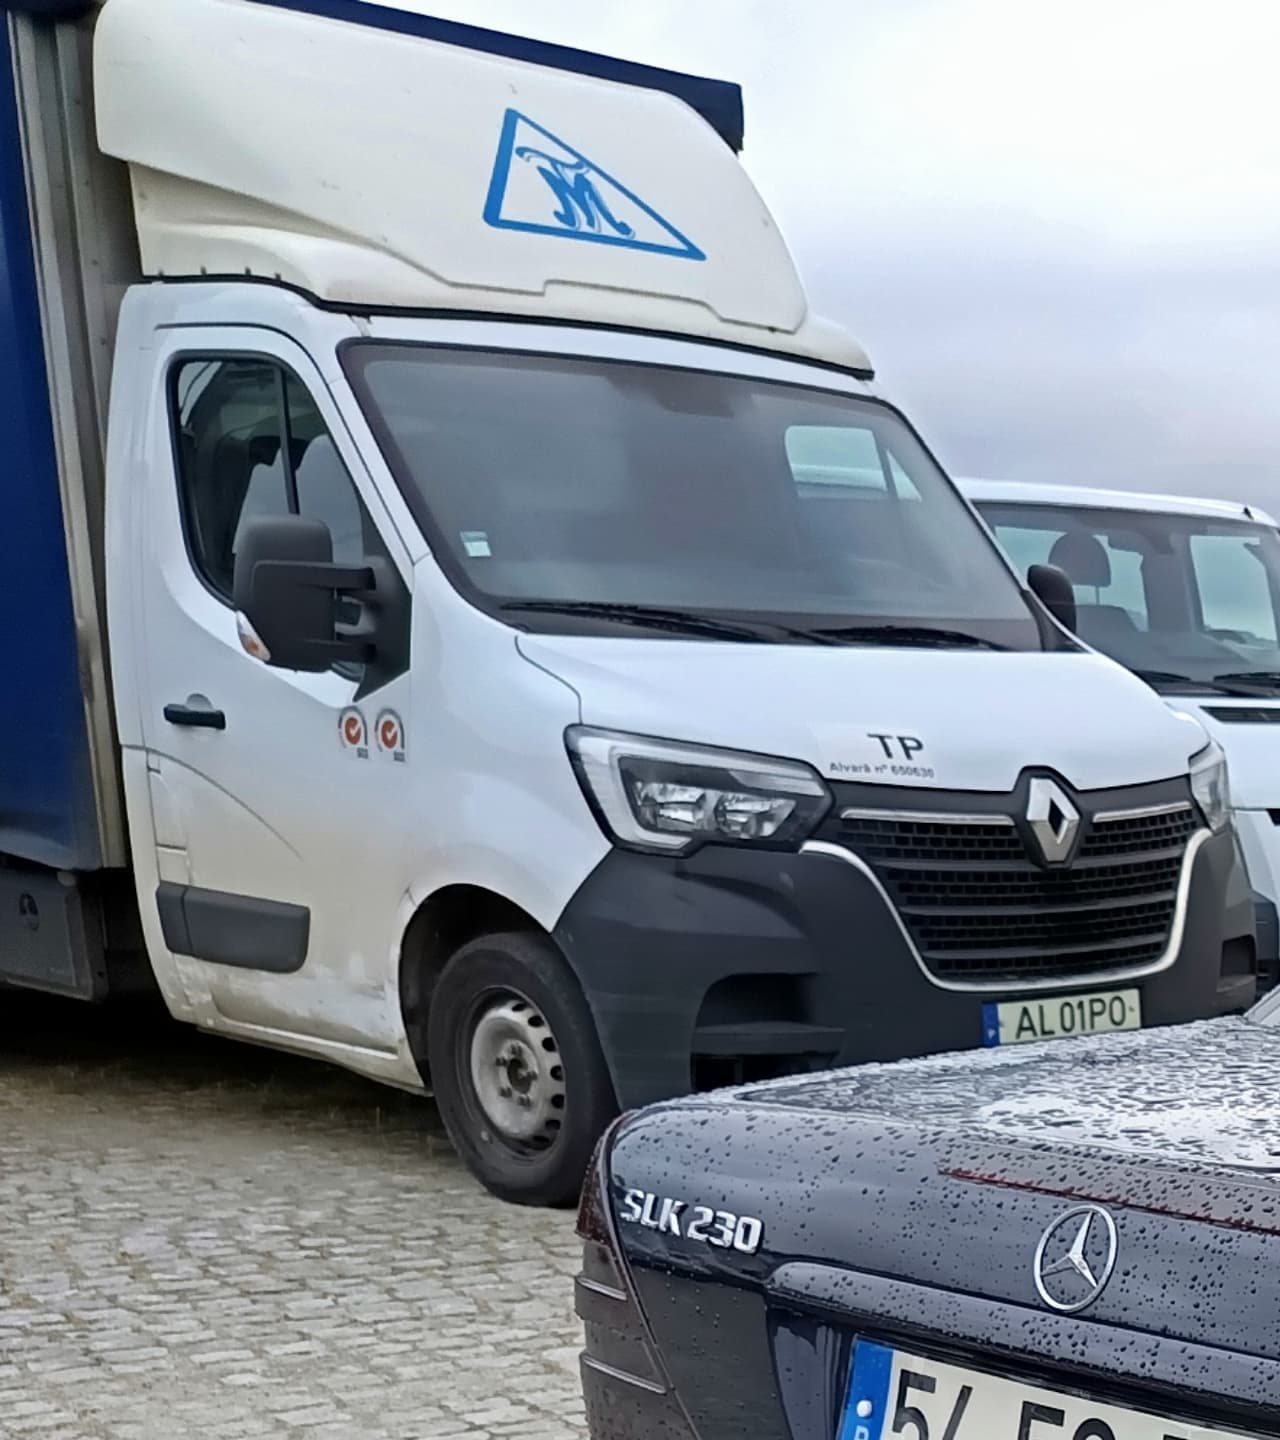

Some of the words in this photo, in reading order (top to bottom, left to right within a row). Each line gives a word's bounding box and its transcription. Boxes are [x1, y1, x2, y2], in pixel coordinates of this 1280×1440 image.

[867, 733, 924, 760] TP
[620, 1188, 687, 1236] SLK
[687, 1206, 763, 1254] 230
